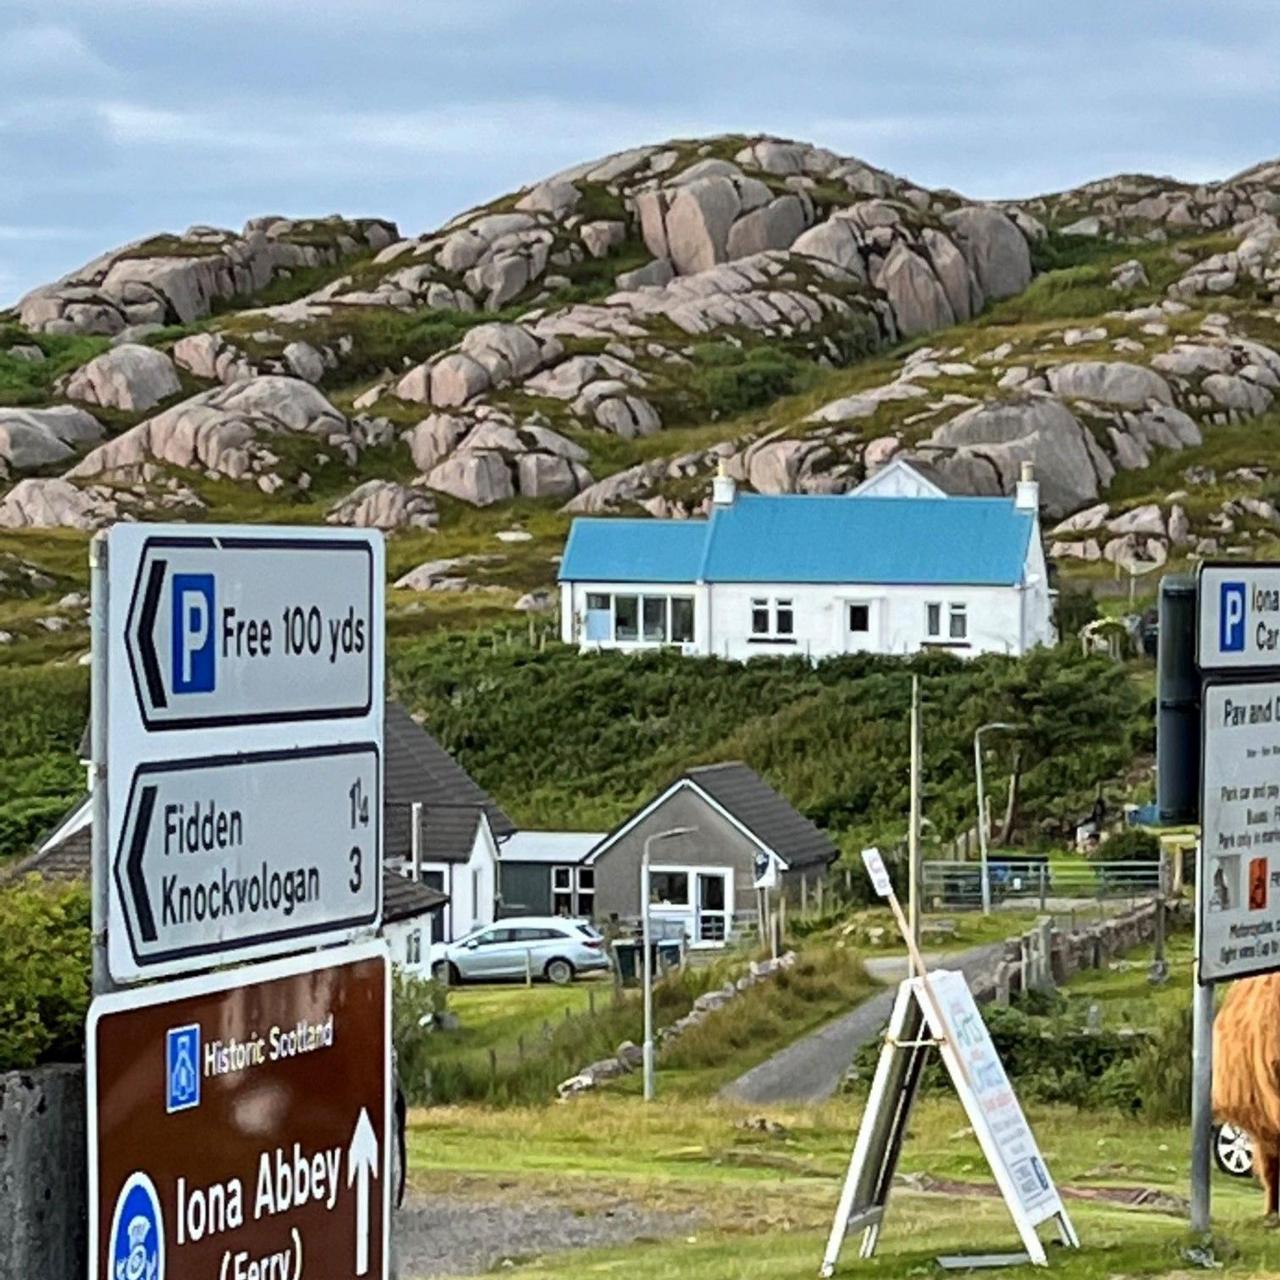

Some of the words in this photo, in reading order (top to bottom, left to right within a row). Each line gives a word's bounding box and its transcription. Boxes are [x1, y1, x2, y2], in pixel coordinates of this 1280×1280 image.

[1252, 582, 1279, 612] Iona
[182, 590, 209, 682] P
[222, 607, 272, 657] Free
[283, 605, 322, 655] 100
[329, 605, 365, 664] yds
[1256, 621, 1279, 650] Car
[1249, 696, 1272, 724] and
[164, 800, 243, 856] Fidden
[162, 861, 320, 927] Knockvologan
[349, 846, 362, 893] 3
[204, 1031, 265, 1077] Historic
[269, 1012, 334, 1060] Scotland
[177, 1177, 243, 1245] Iona
[254, 1142, 342, 1219] Abbey
